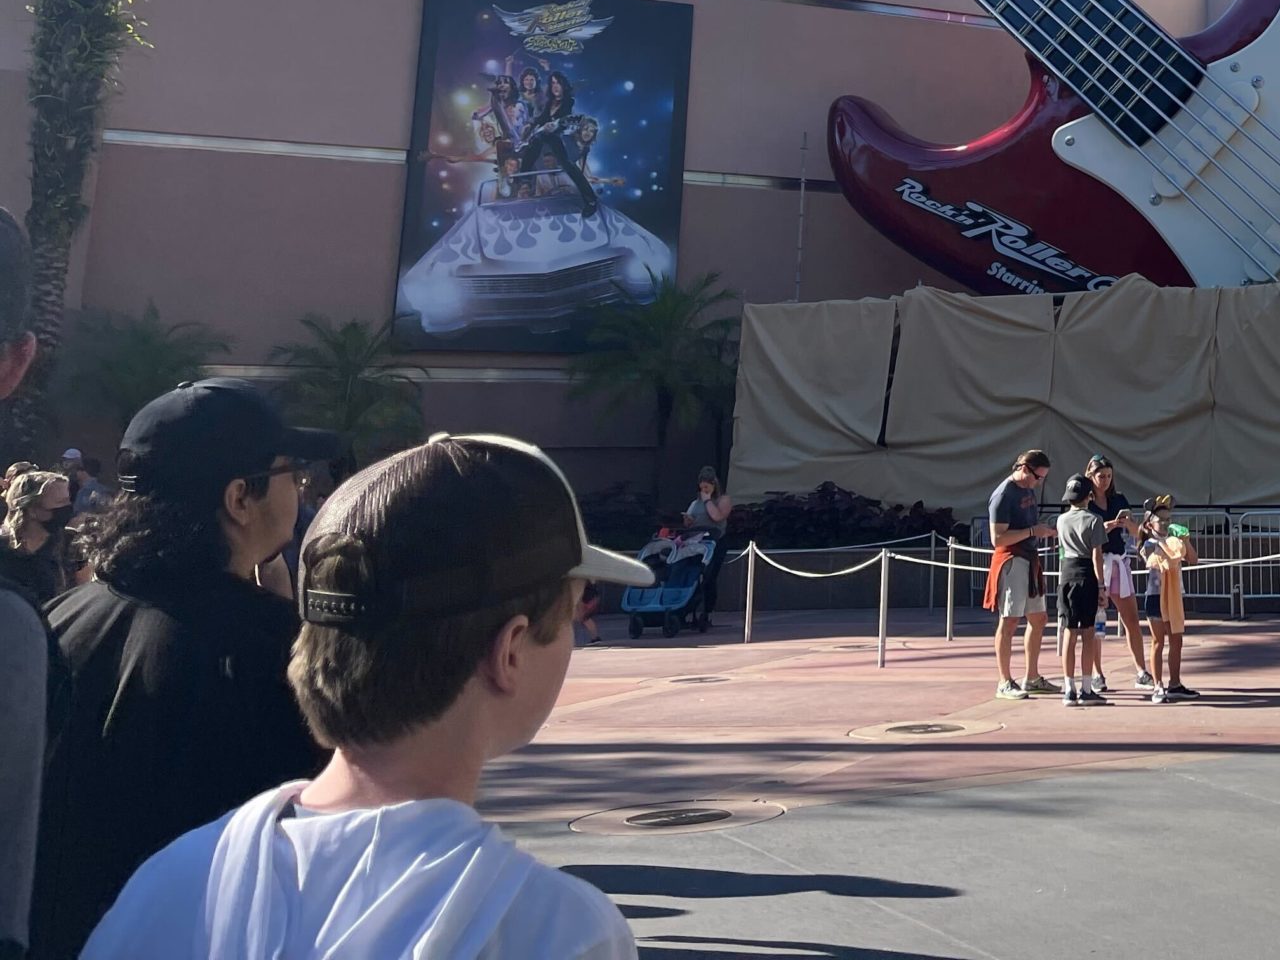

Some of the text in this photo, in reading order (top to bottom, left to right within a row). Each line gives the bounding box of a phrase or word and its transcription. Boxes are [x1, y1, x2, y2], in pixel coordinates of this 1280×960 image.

[895, 178, 986, 225] Rock'n'
[961, 201, 1093, 282] Roller
[987, 261, 1052, 294] Starrin
